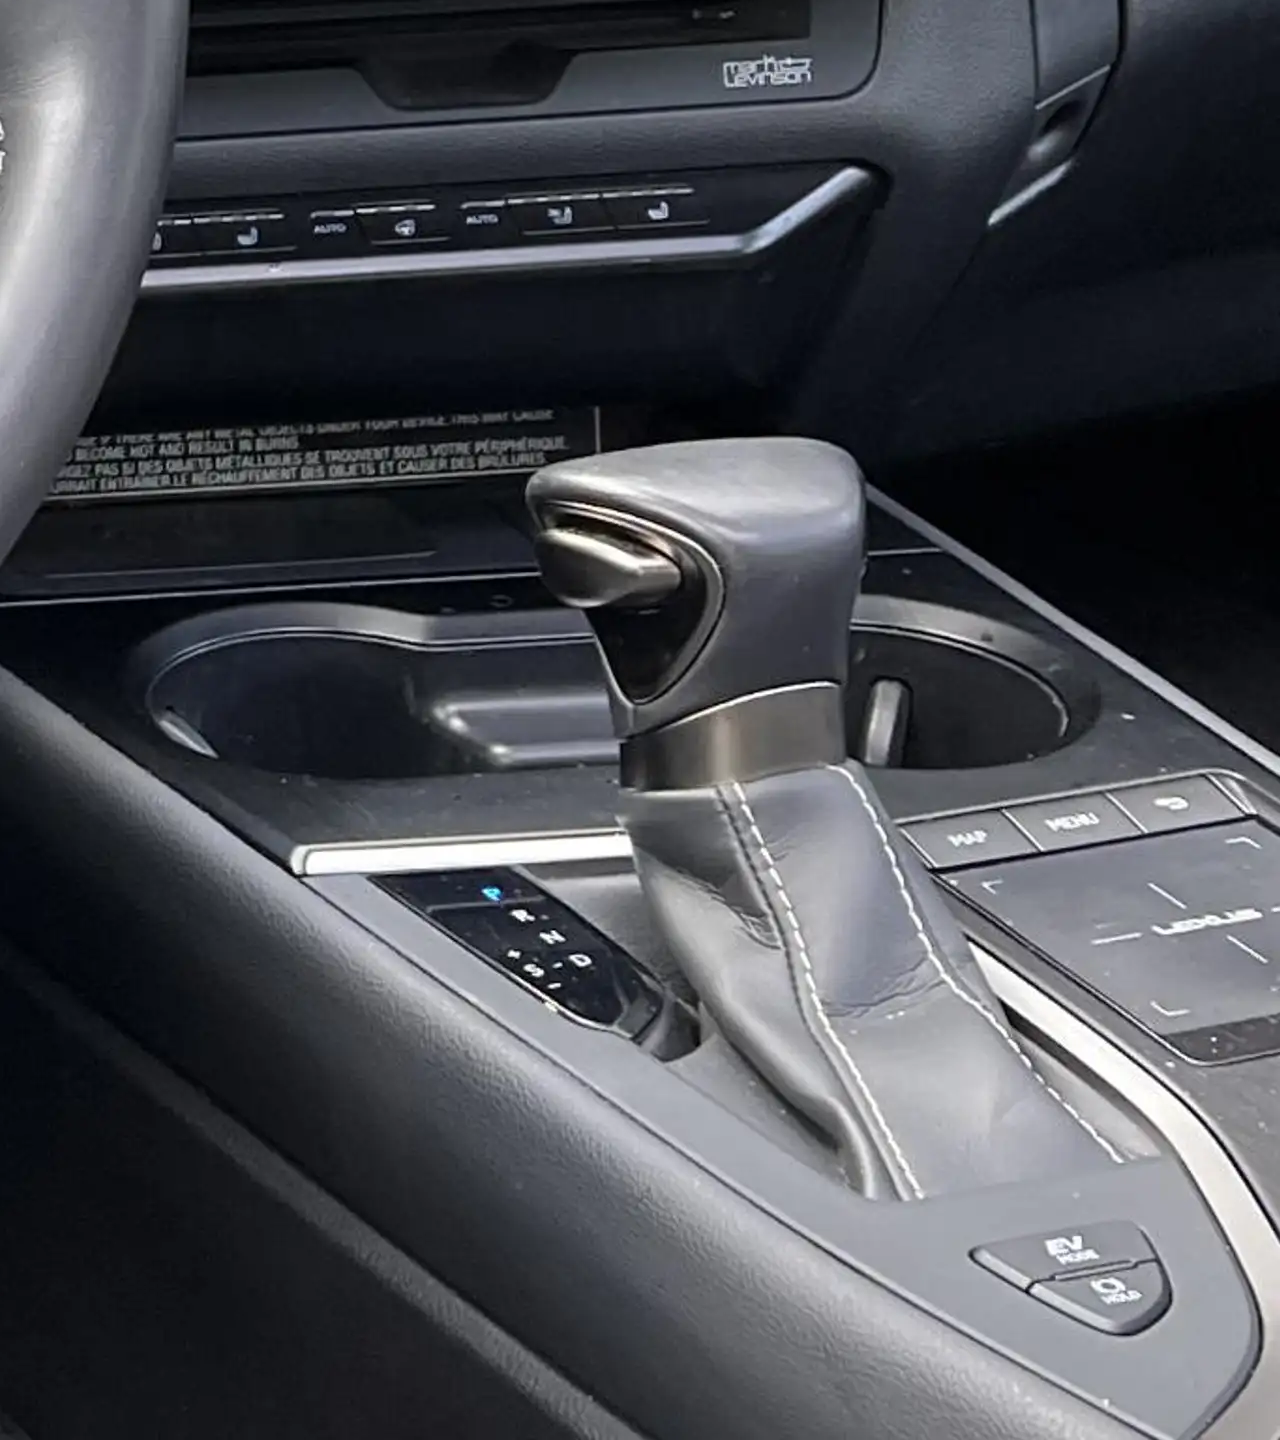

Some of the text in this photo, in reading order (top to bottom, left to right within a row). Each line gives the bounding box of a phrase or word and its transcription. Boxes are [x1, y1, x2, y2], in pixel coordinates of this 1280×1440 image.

[466, 214, 499, 225] AUTO
[314, 223, 347, 234] AUTO
[1044, 812, 1100, 833] MENU
[947, 829, 988, 847] MAP
[481, 886, 502, 901] P
[539, 929, 567, 945] N
[568, 953, 592, 968] D
[523, 963, 545, 978] S
[1044, 1235, 1083, 1257] EV
